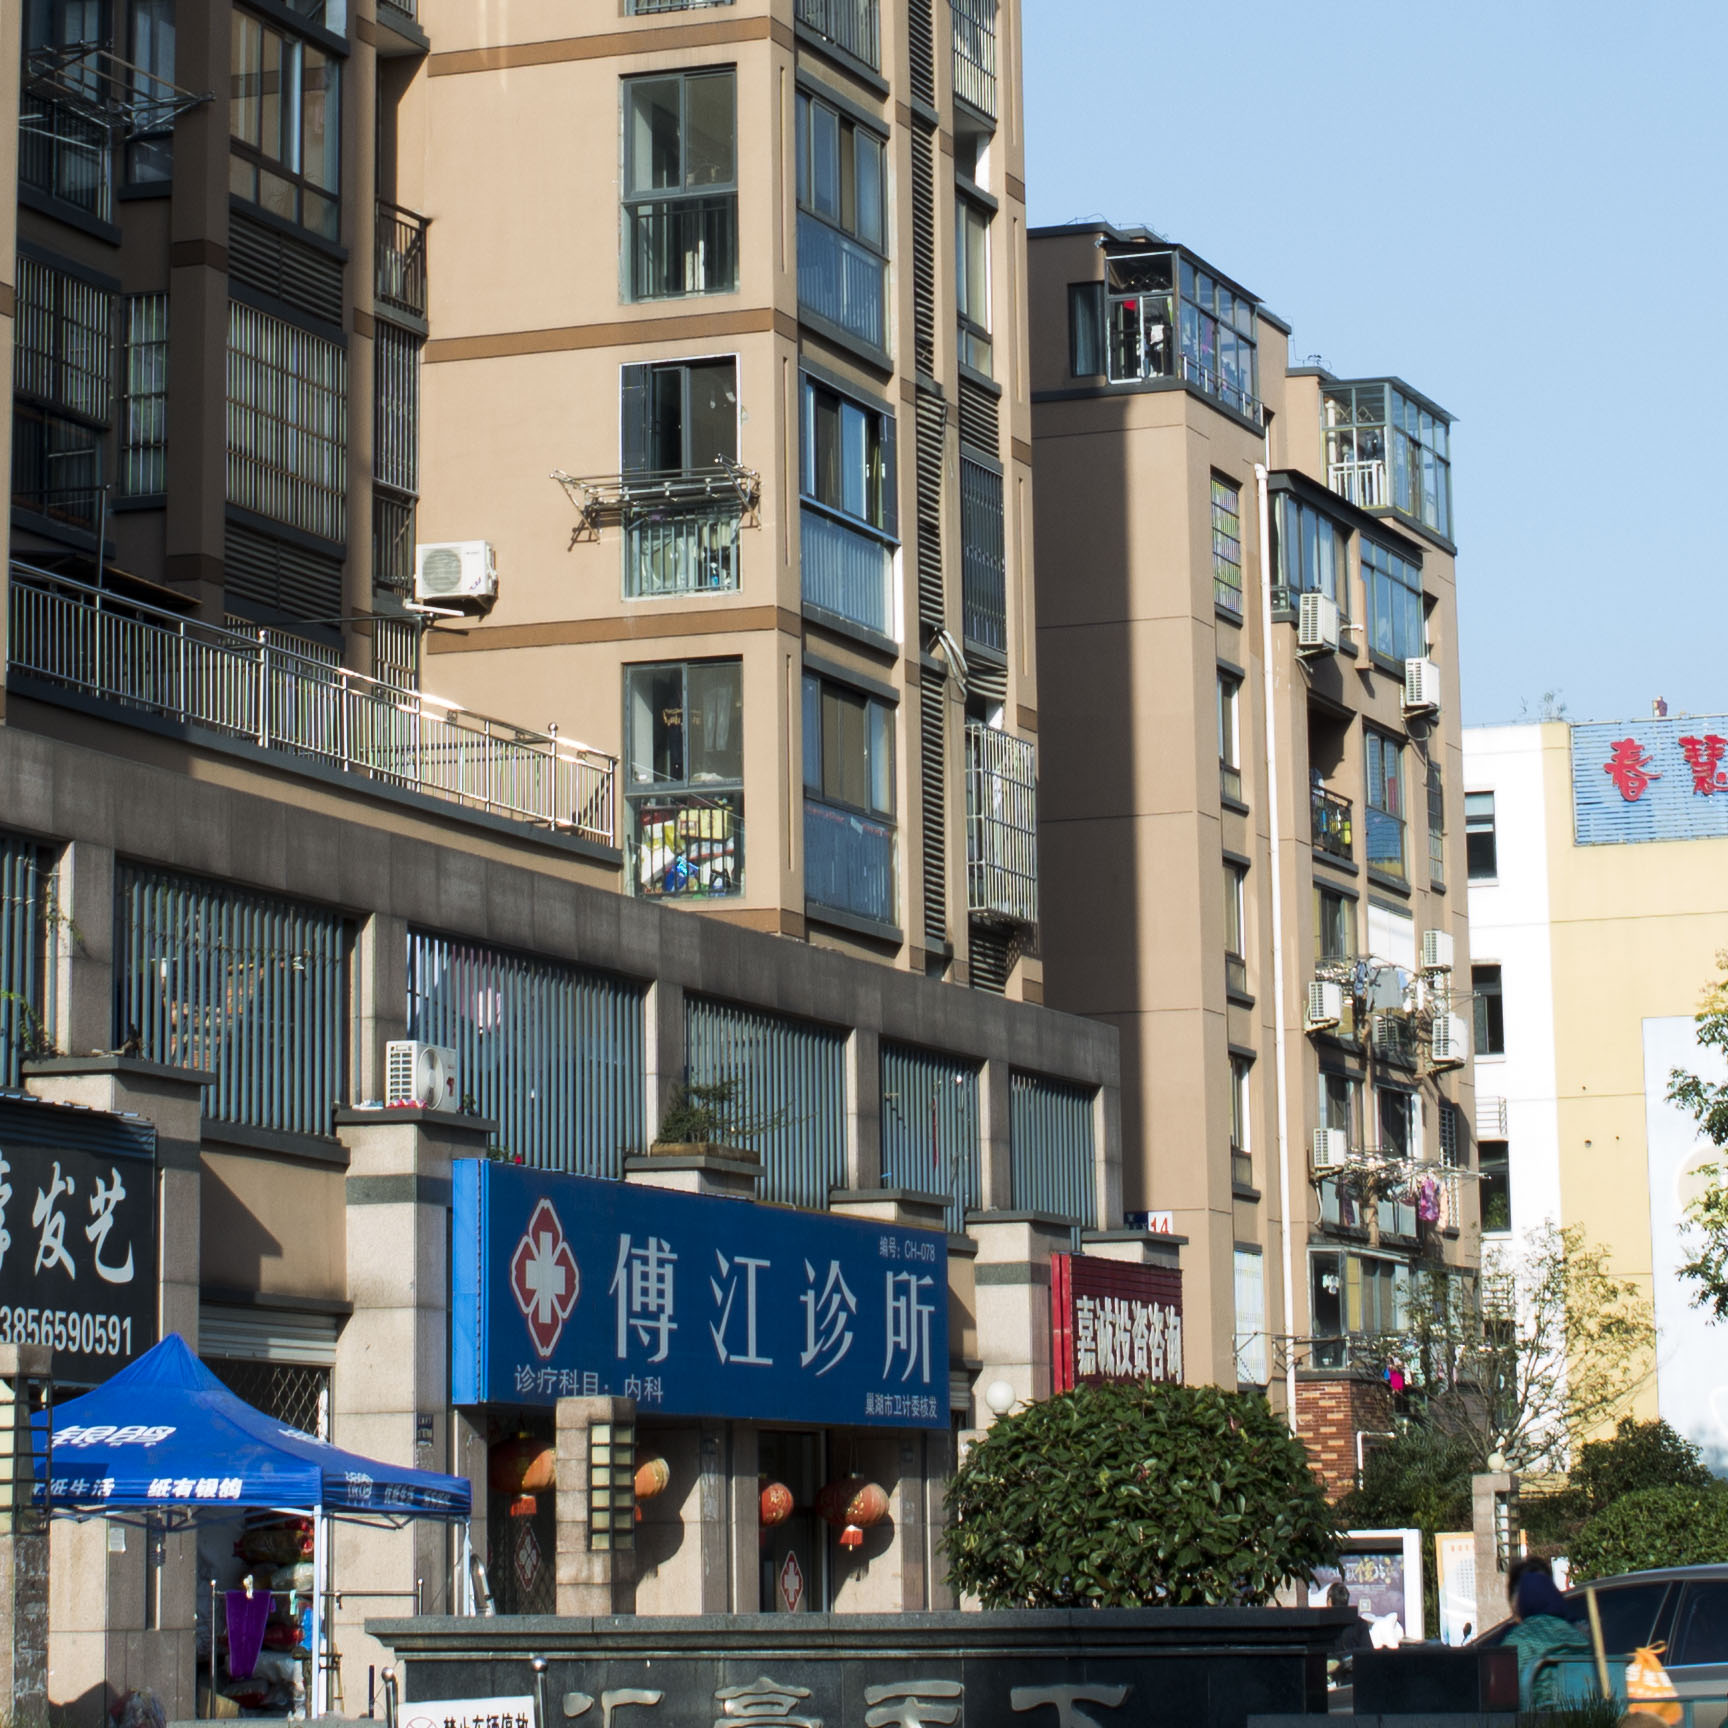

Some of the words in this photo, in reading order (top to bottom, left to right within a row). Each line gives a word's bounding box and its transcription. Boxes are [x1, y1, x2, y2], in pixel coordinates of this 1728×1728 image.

[1150, 1216, 1169, 1234] 14
[904, 1239, 936, 1263] CH-078
[610, 1233, 934, 1384] 傅江诊所
[1075, 1294, 1183, 1385] 嘉诚投资咨询
[624, 1373, 664, 1404] 内科
[865, 1391, 938, 1420] 巢湖市卫计委核发
